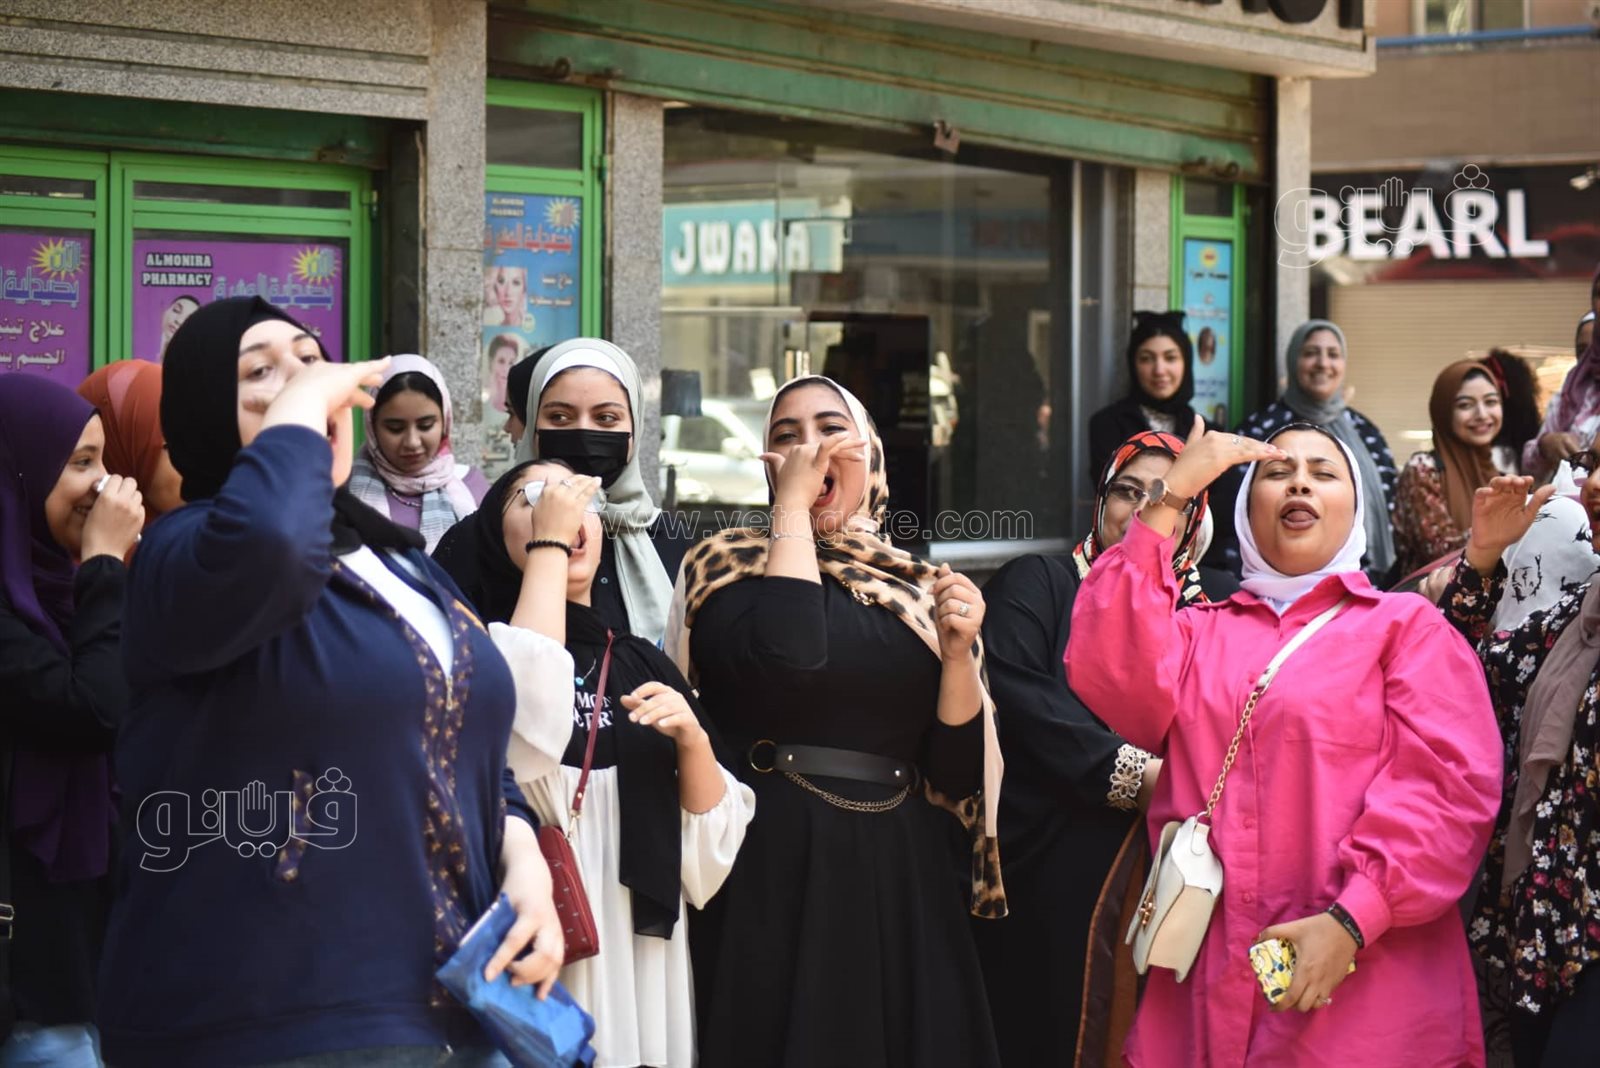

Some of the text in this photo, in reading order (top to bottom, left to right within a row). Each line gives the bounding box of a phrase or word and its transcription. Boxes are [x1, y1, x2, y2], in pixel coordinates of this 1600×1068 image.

[1307, 189, 1549, 260] BEARL
[146, 253, 212, 267] ALMONIRA
[142, 272, 213, 286] PHARMACY
[29, 320, 65, 343] علاج
[17, 349, 65, 371] الجسم
